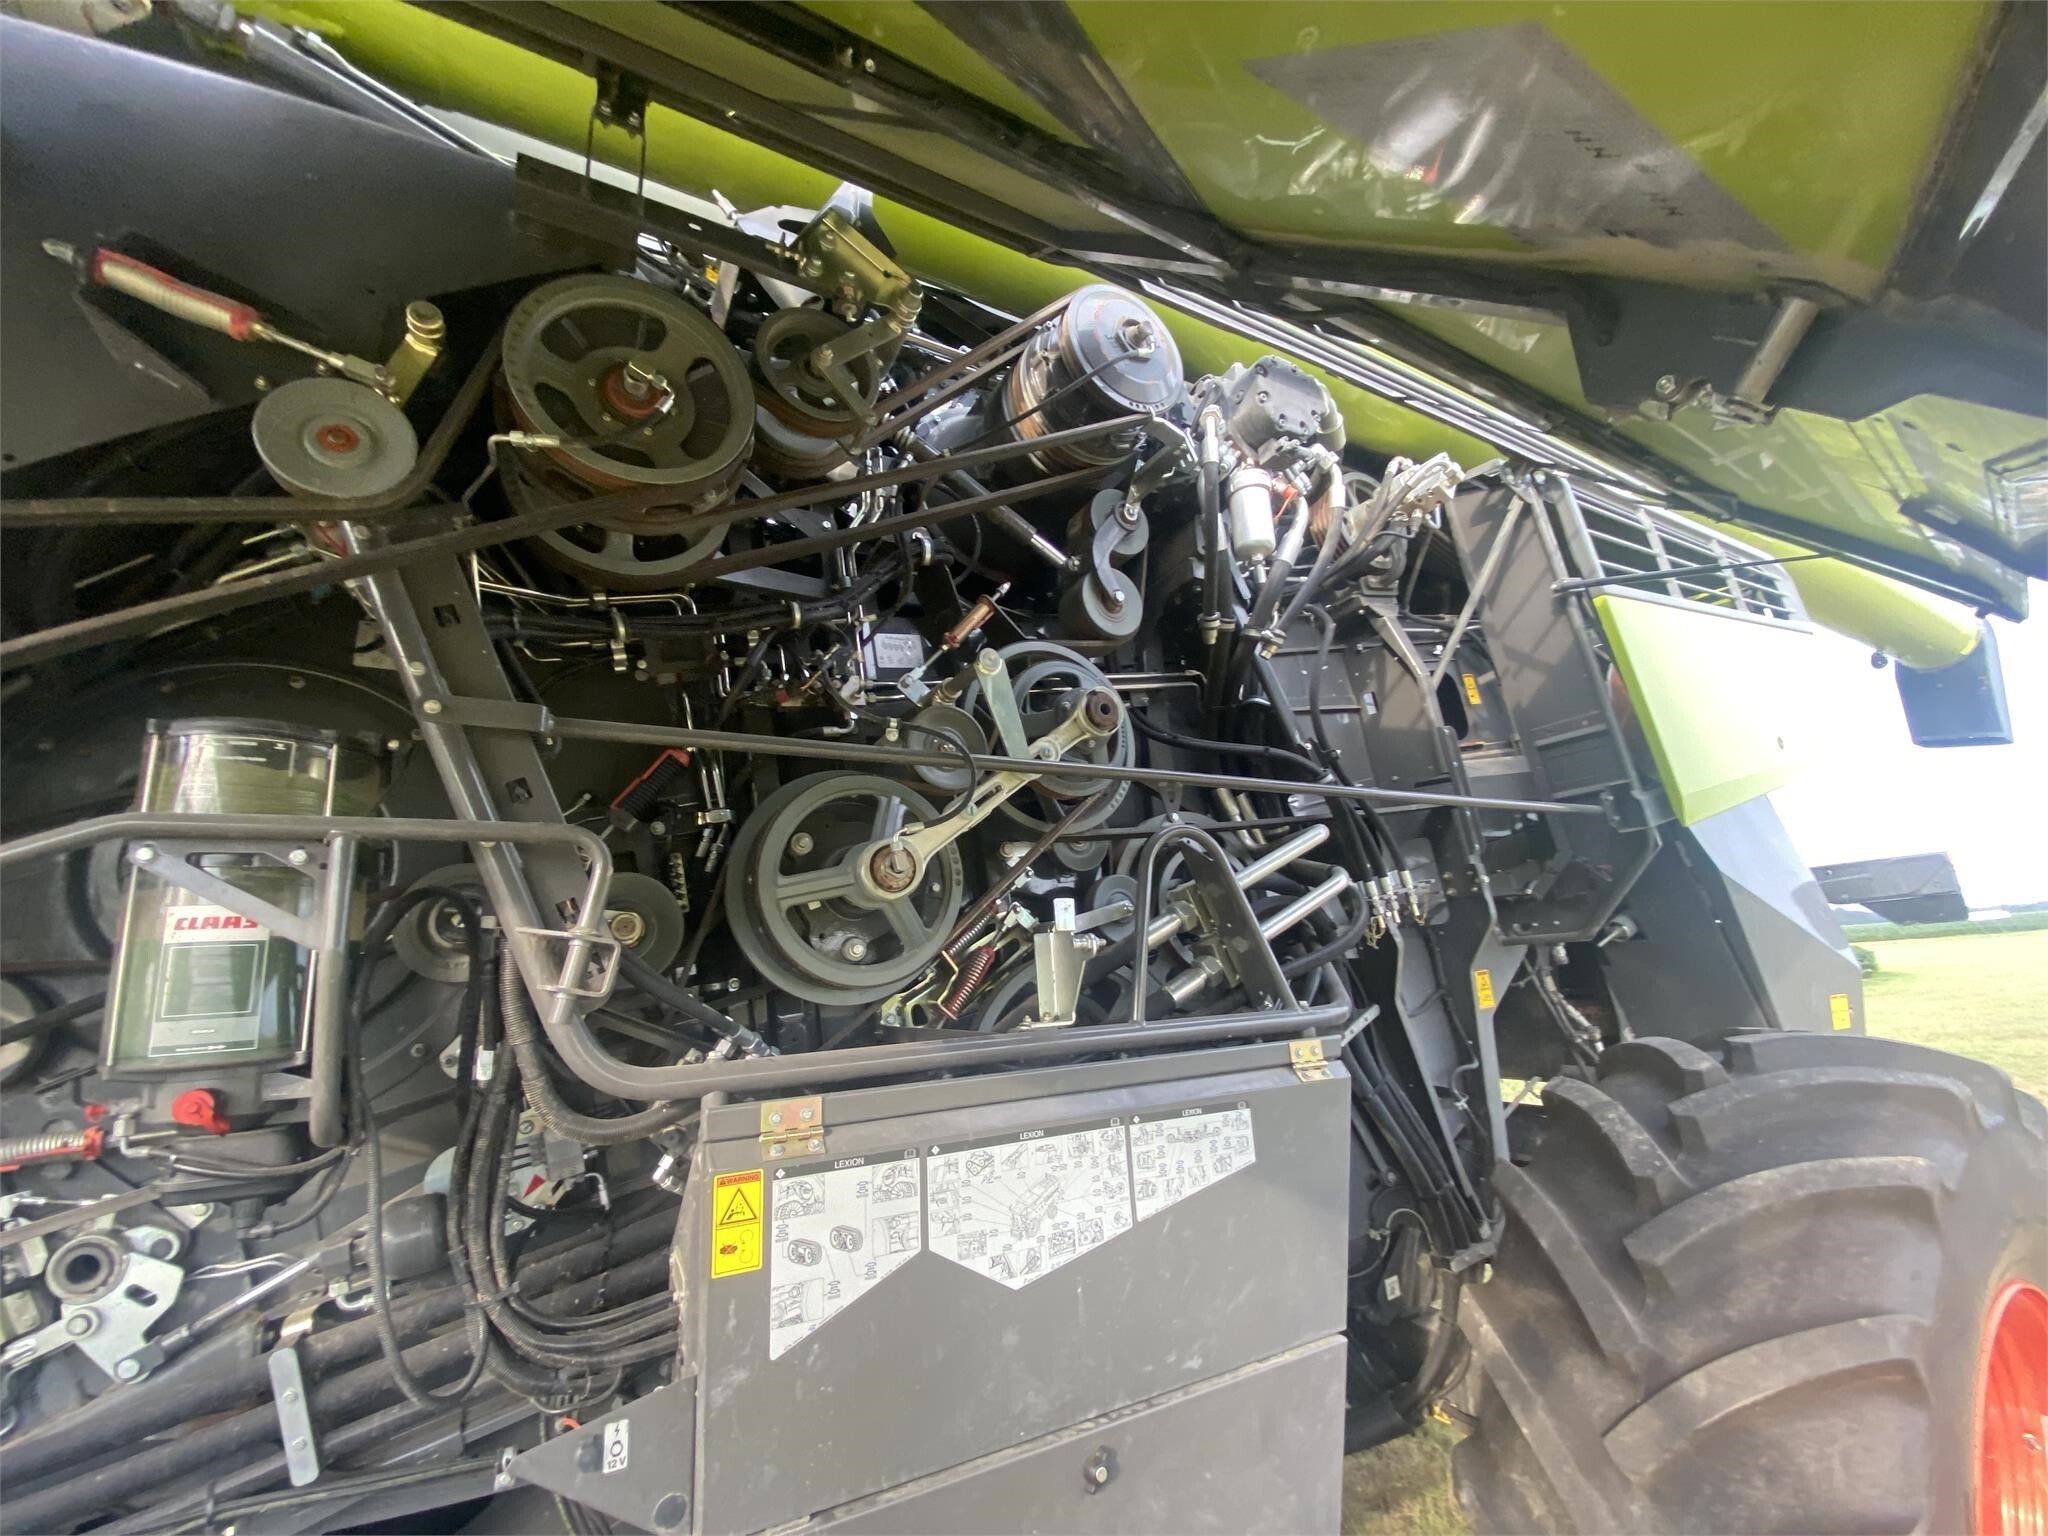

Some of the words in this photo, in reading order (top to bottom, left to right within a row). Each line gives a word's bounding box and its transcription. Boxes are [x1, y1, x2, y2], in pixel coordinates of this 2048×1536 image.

[174, 916, 258, 930] CLAAS
[1019, 1129, 1044, 1140] LEXION
[834, 1157, 865, 1169] LEXION
[607, 1459, 617, 1469] 12
[619, 1456, 626, 1466] V
